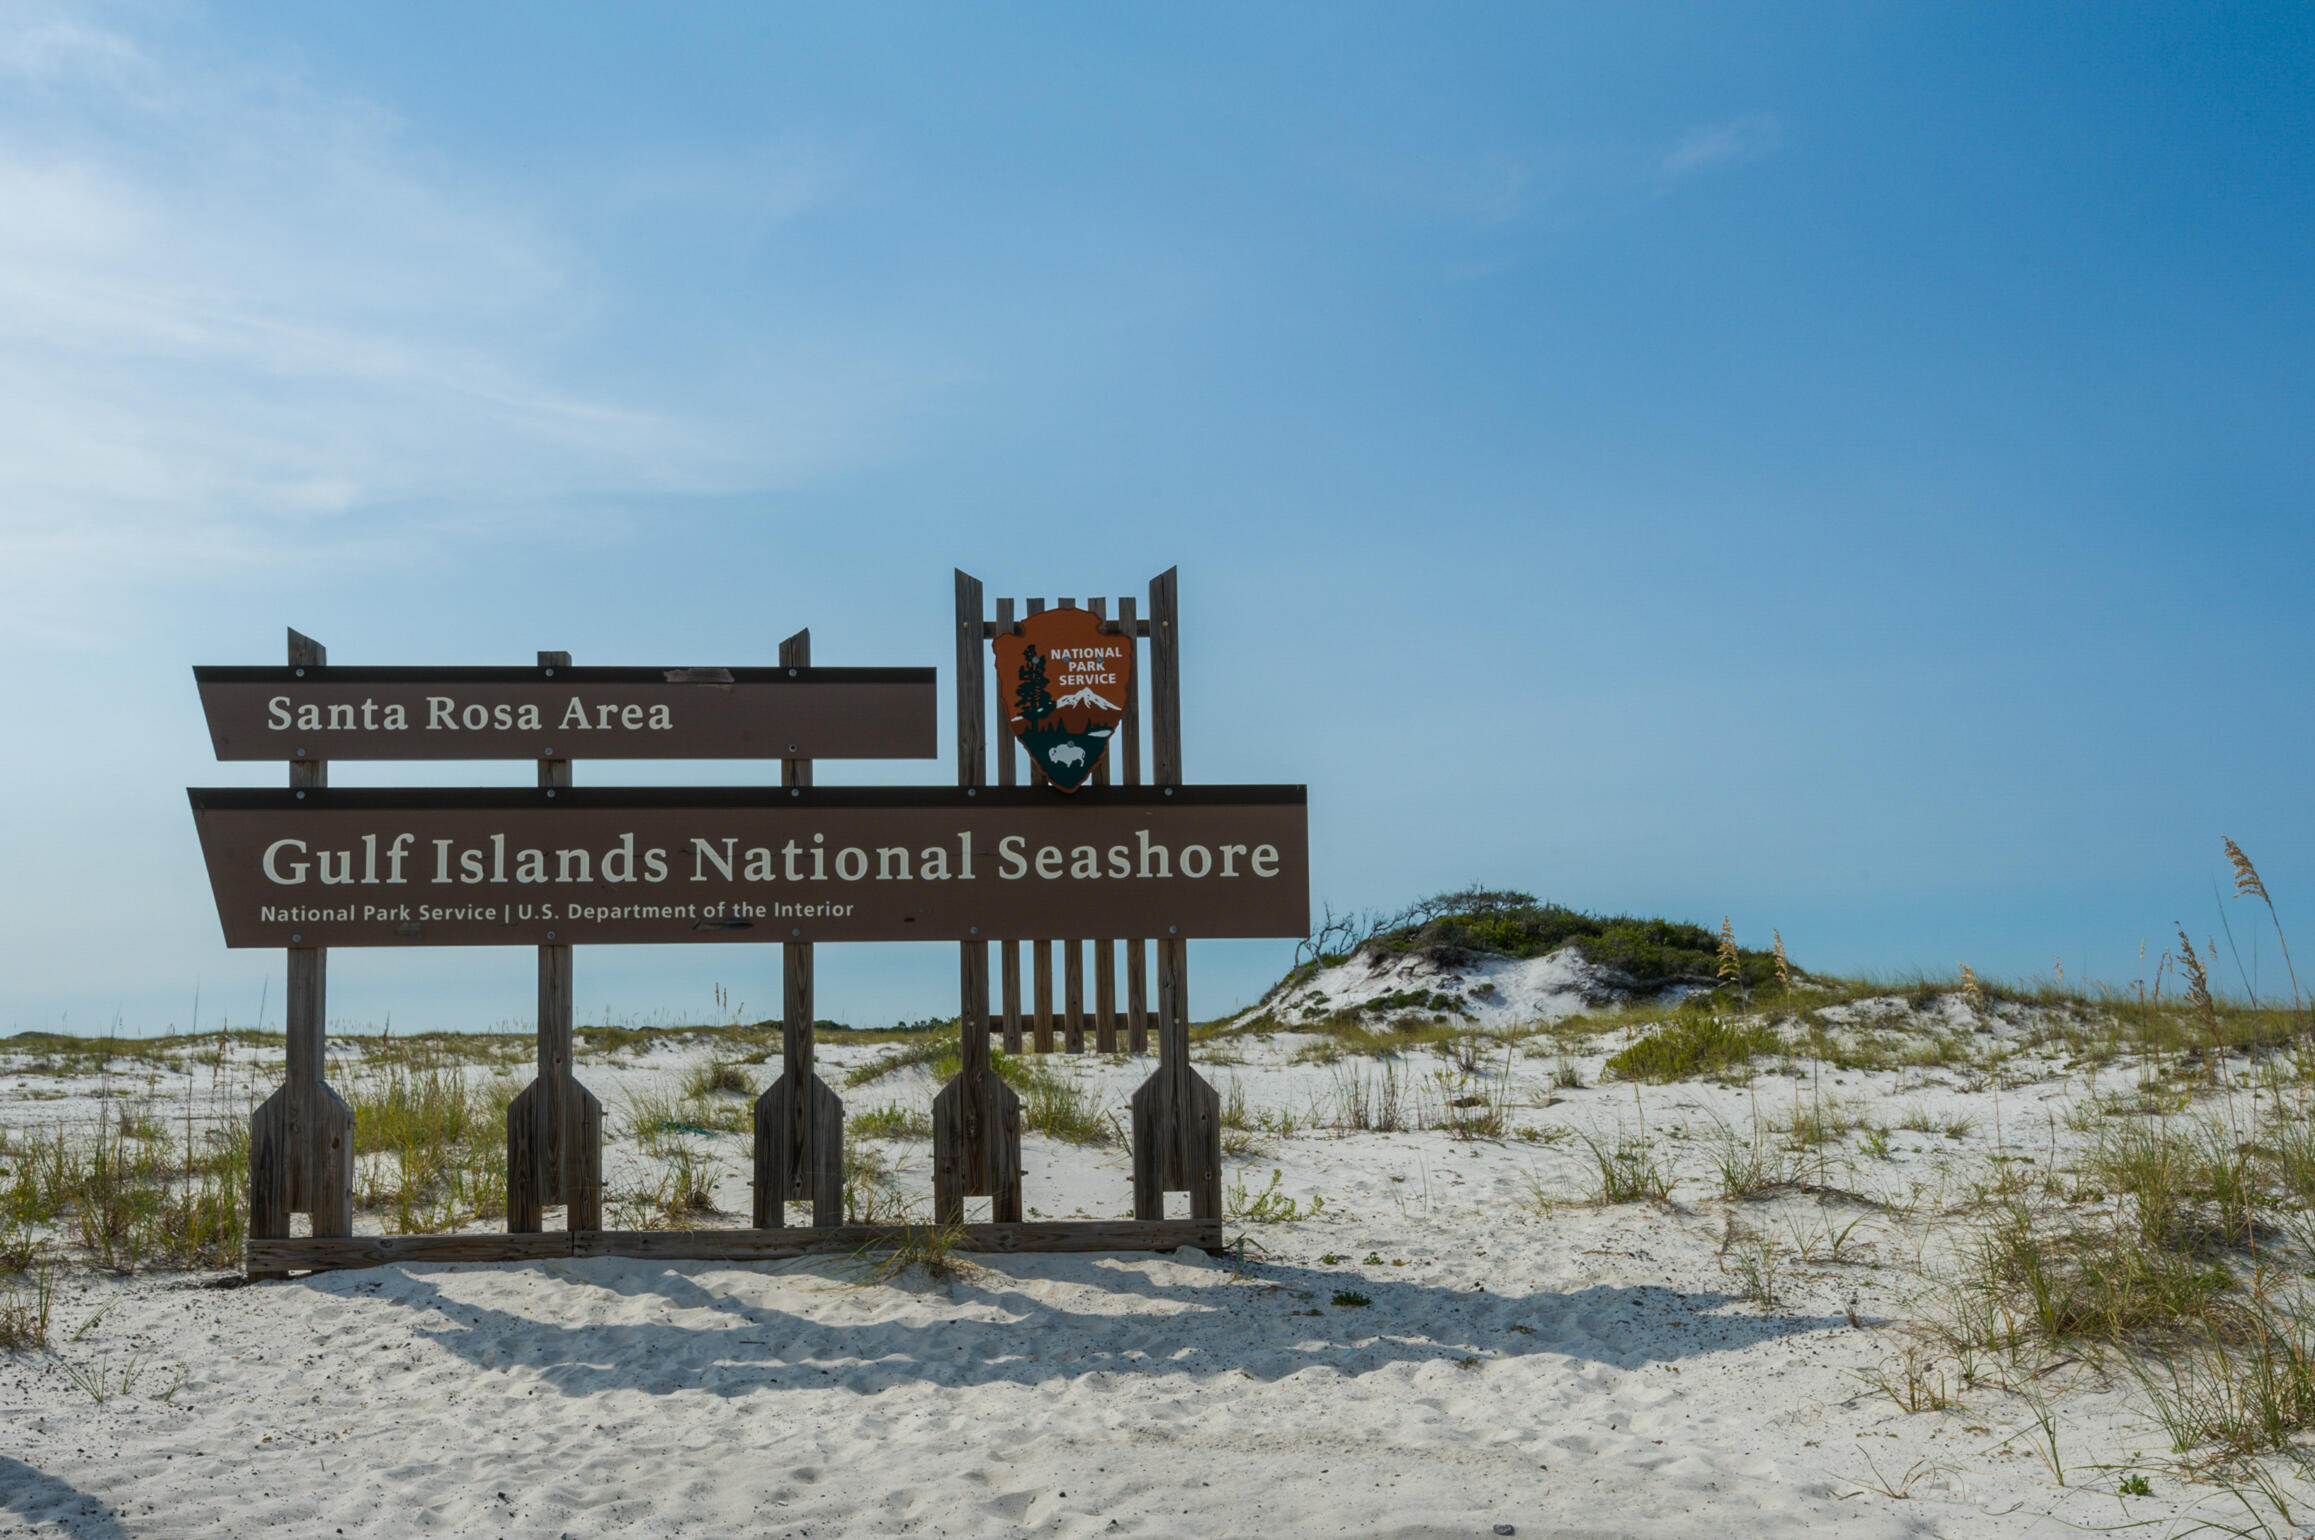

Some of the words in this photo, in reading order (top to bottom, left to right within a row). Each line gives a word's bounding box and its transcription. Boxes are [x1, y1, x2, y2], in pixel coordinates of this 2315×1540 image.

[1050, 647, 1123, 660] NATIONAL
[1068, 660, 1105, 672] PARK
[1059, 673, 1116, 686] SERVICE
[268, 696, 409, 731] Santa
[425, 696, 542, 730] Rosa
[558, 696, 673, 730] Area
[262, 832, 415, 885] Gulf
[431, 832, 668, 884] Islands
[690, 831, 976, 882] National
[998, 829, 1280, 880] Seashore
[261, 904, 355, 922] National
[364, 904, 410, 921] Park
[419, 904, 497, 921] Service
[518, 904, 559, 920] U.S.
[568, 904, 696, 922] Department
[703, 901, 726, 918] of
[733, 901, 766, 918] the
[775, 901, 854, 917] Interior
